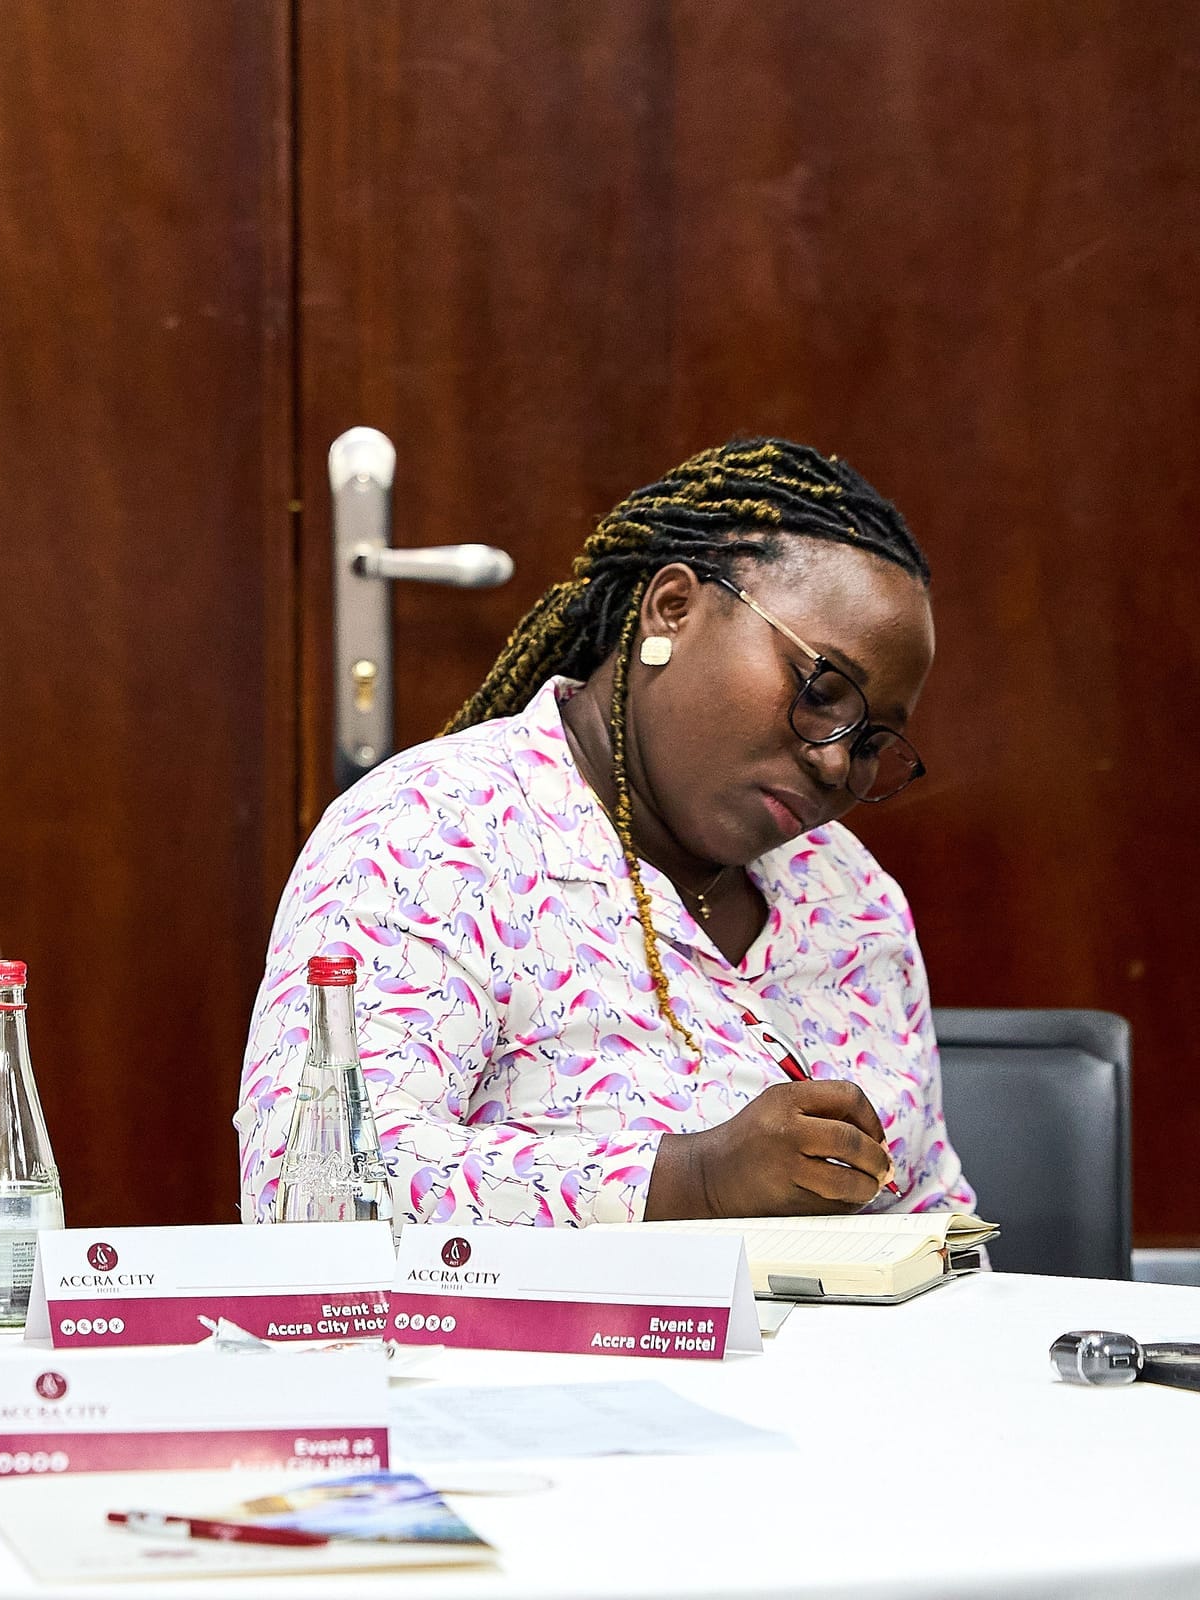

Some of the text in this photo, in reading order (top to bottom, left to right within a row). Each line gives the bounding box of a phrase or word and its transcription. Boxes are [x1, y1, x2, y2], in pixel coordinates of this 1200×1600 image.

[59, 1273, 155, 1288] ACCRA CITY
[407, 1268, 501, 1285] ACCRA CITY
[321, 1302, 390, 1318] Event at
[267, 1317, 387, 1336] Accra City Hot
[649, 1317, 714, 1333] Event at
[591, 1332, 716, 1352] Accra City Hotel
[294, 1436, 375, 1456] Event at
